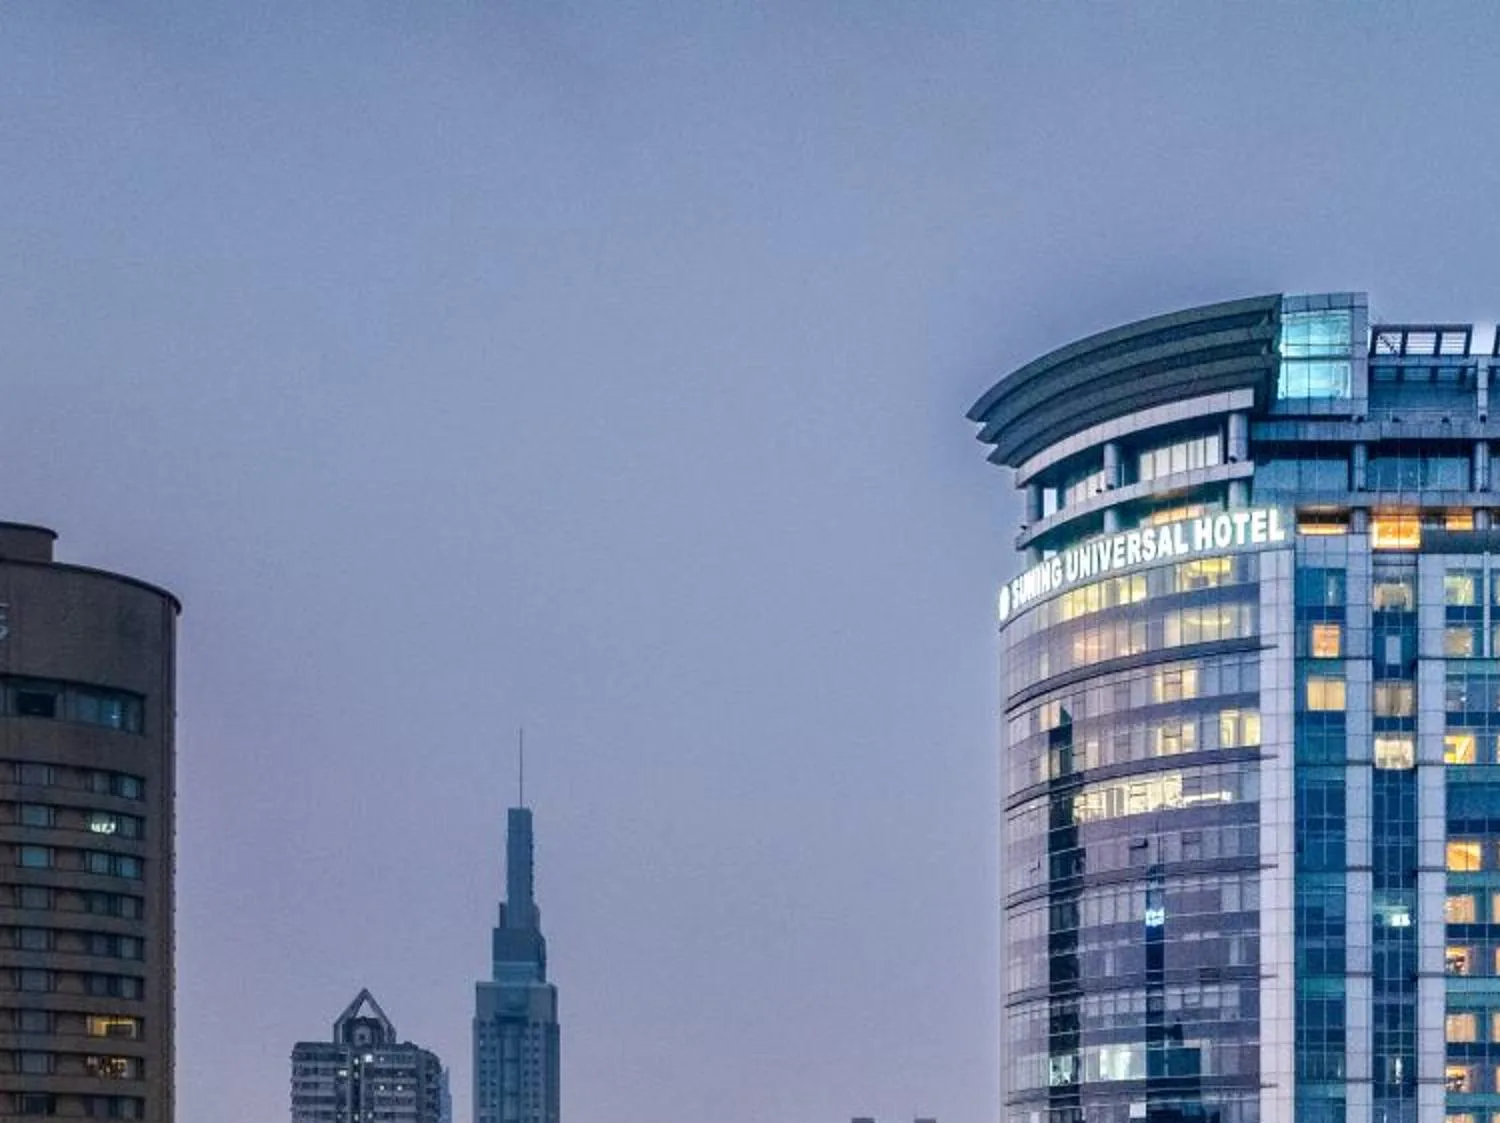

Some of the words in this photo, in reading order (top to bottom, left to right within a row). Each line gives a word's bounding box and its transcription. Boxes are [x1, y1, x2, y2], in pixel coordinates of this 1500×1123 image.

[1011, 559, 1063, 609] SUNING
[1066, 524, 1189, 582] UNIVERSAL
[1194, 508, 1285, 552] HOTEL
